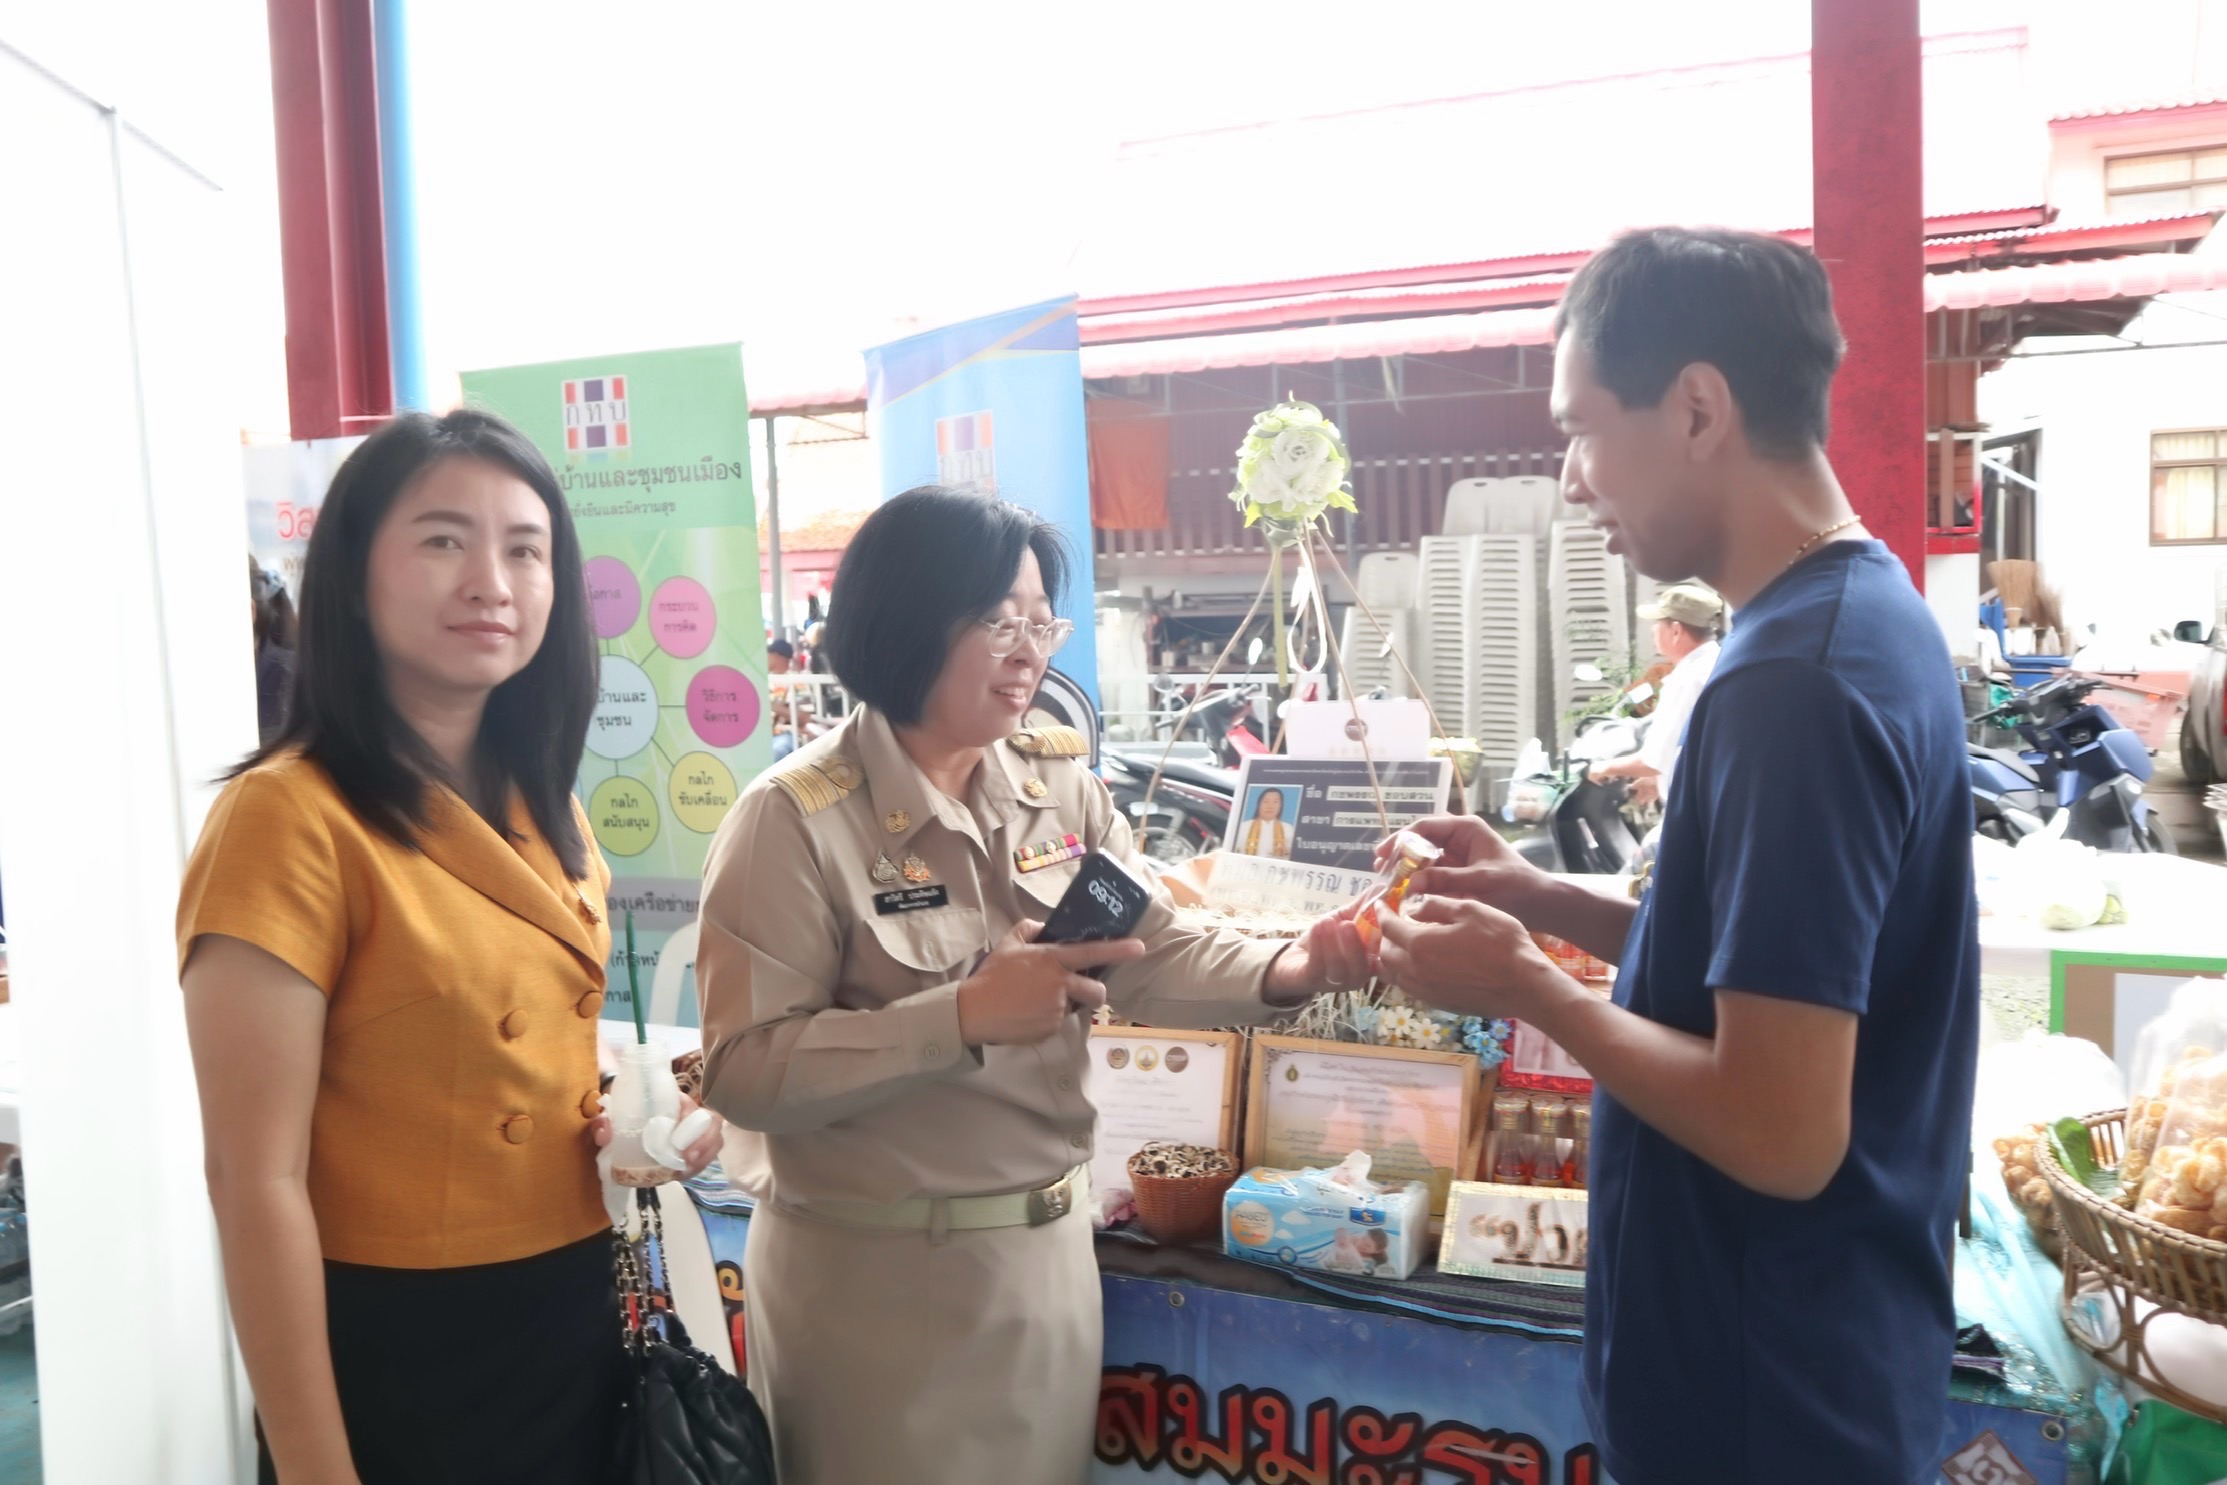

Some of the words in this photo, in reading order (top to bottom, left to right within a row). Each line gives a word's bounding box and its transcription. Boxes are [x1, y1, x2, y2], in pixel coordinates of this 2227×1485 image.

[554, 456, 742, 493] บ้านและชุมชนเมือง
[596, 714, 632, 731] ชุมชน
[688, 770, 714, 785] กลไก
[611, 793, 638, 809] กลไก
[603, 814, 650, 832] สนับสนุน
[608, 891, 700, 912] องเครือข่าย
